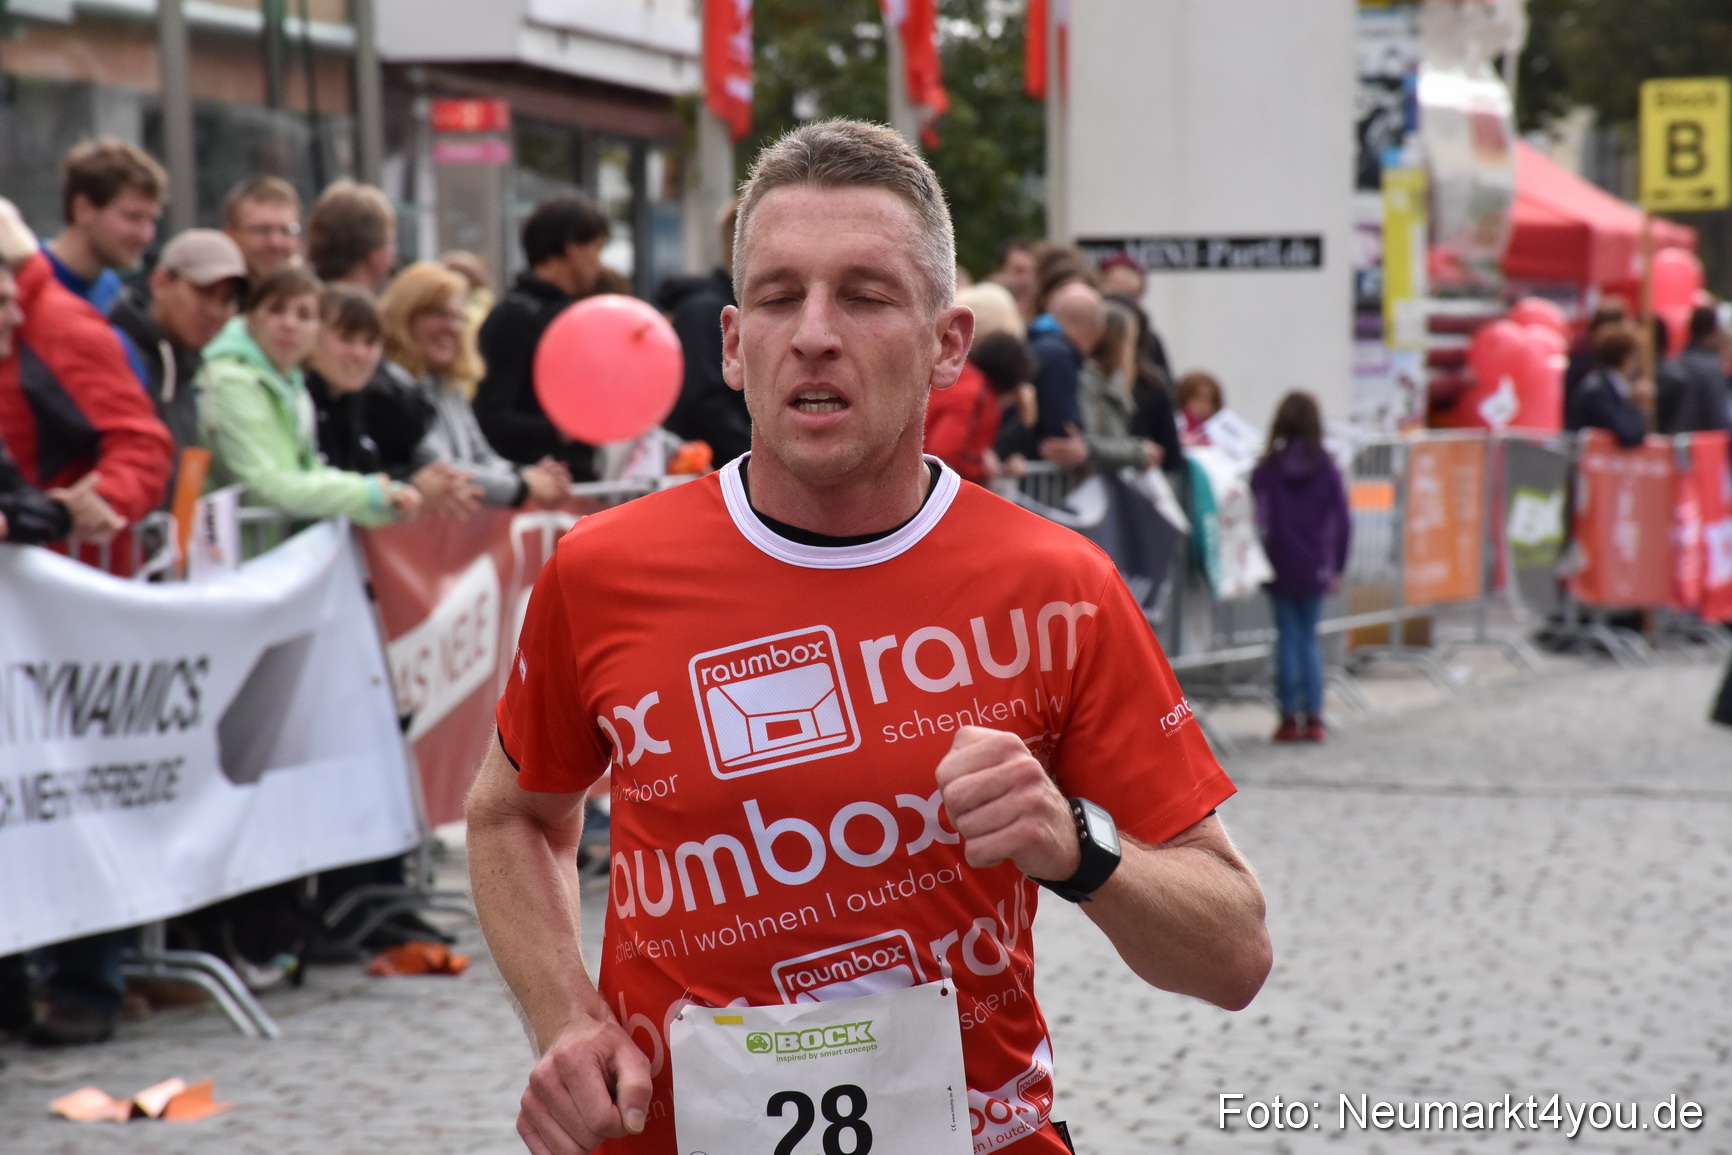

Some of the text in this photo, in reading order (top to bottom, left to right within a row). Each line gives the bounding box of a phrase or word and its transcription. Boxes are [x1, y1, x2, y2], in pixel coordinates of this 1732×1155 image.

[1666, 121, 1706, 179] B
[701, 641, 827, 686] raumbox
[882, 697, 1027, 743] schenken
[612, 788, 960, 918] aumbox
[694, 903, 819, 952] wohnen
[846, 861, 964, 913] outdoor
[785, 945, 906, 992] raumbox
[774, 1020, 877, 1054] BOCK
[775, 1044, 878, 1063] inspired by smart concepts
[766, 1084, 873, 1155] 28
